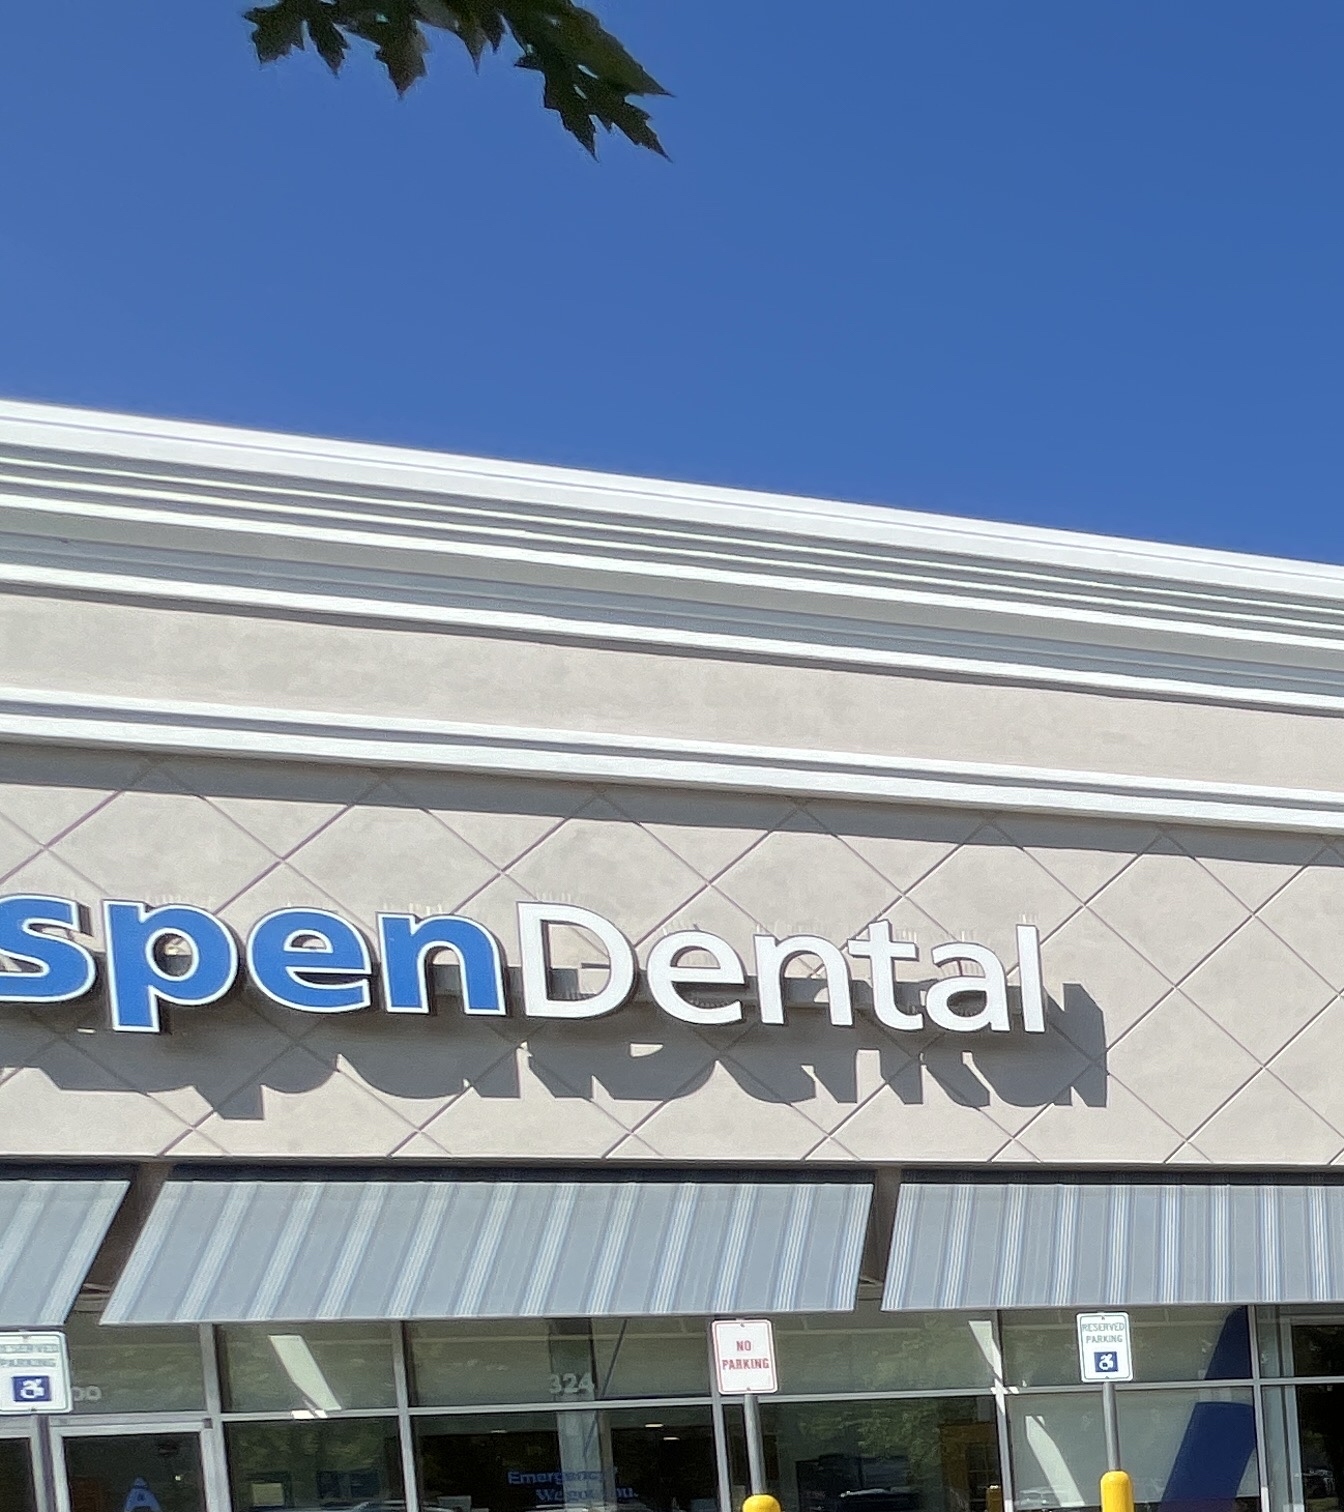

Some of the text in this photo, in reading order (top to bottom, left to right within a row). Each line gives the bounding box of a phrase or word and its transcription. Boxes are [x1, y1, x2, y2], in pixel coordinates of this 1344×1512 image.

[1082, 1322, 1125, 1333] RESERVED
[1086, 1335, 1123, 1344] PARKING
[736, 1340, 752, 1352] NO
[722, 1358, 770, 1370] PARKING
[548, 1373, 595, 1395] 324
